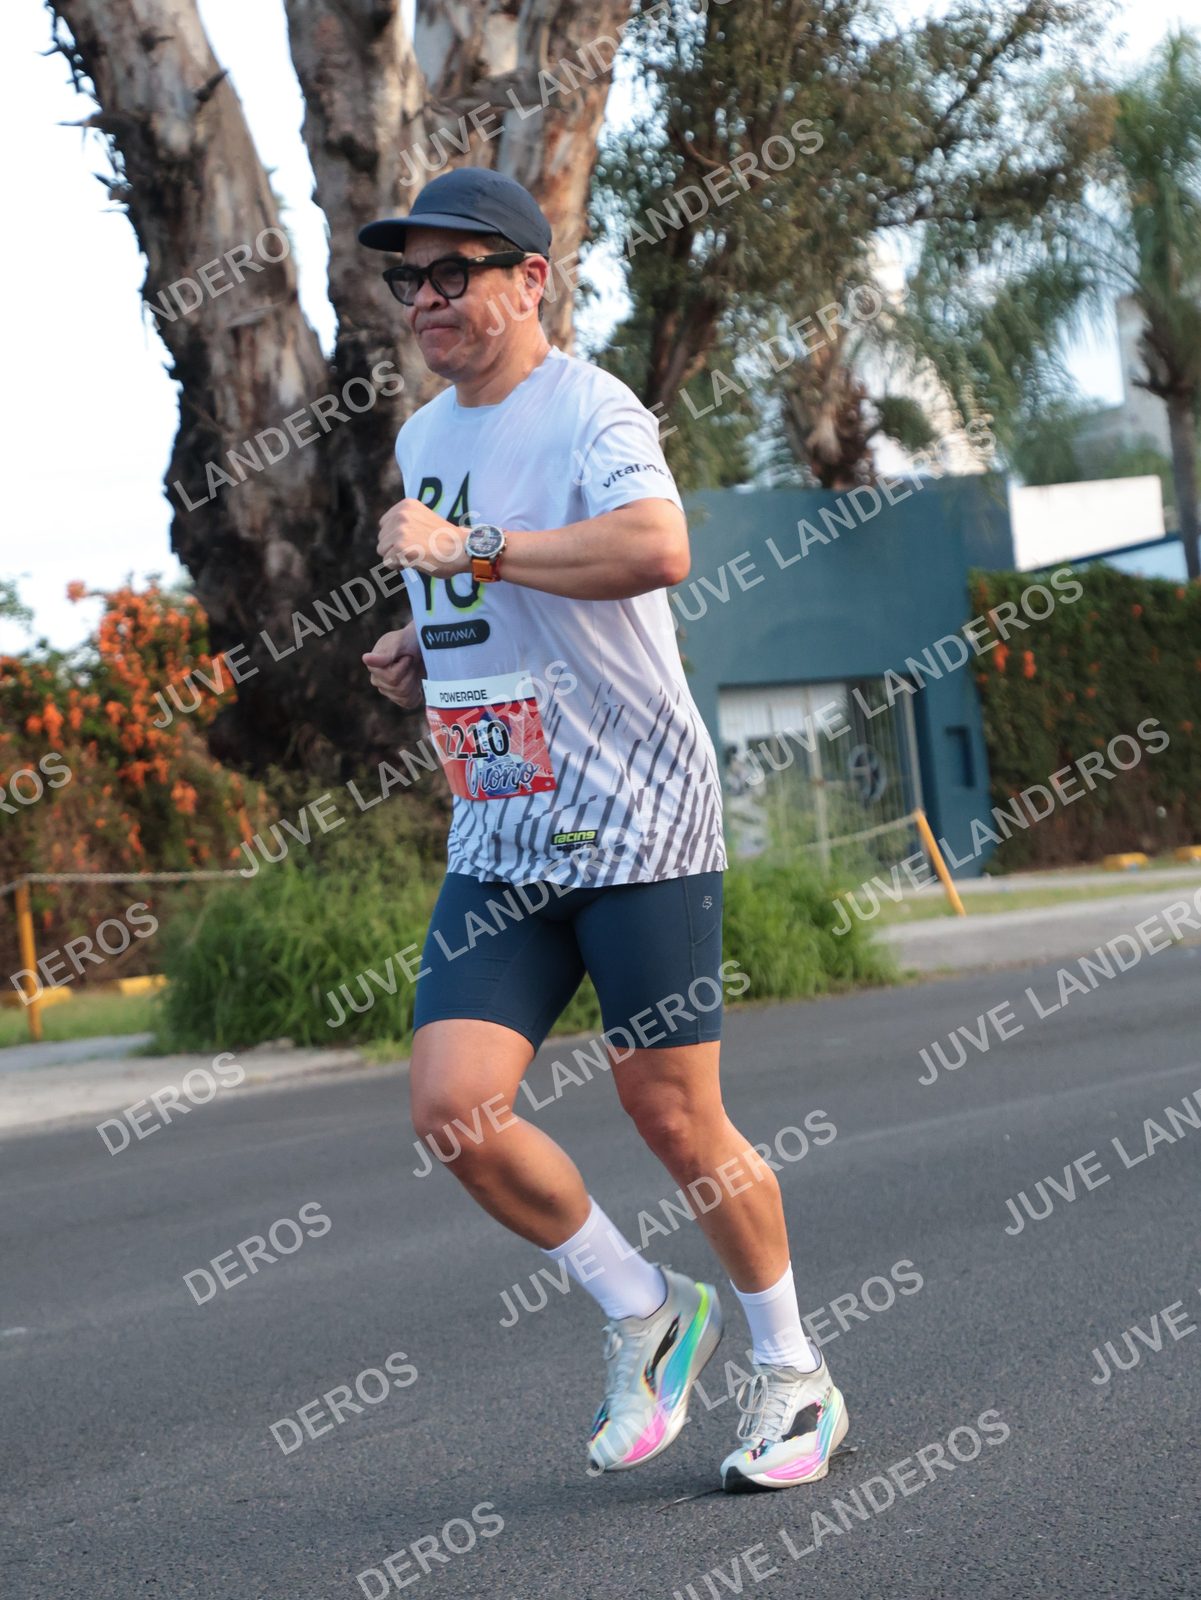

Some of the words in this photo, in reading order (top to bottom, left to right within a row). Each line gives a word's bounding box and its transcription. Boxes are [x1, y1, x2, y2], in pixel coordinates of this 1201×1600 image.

[440, 689, 488, 702] POWERADE
[441, 722, 510, 760] 2210
[553, 830, 596, 844] racing
